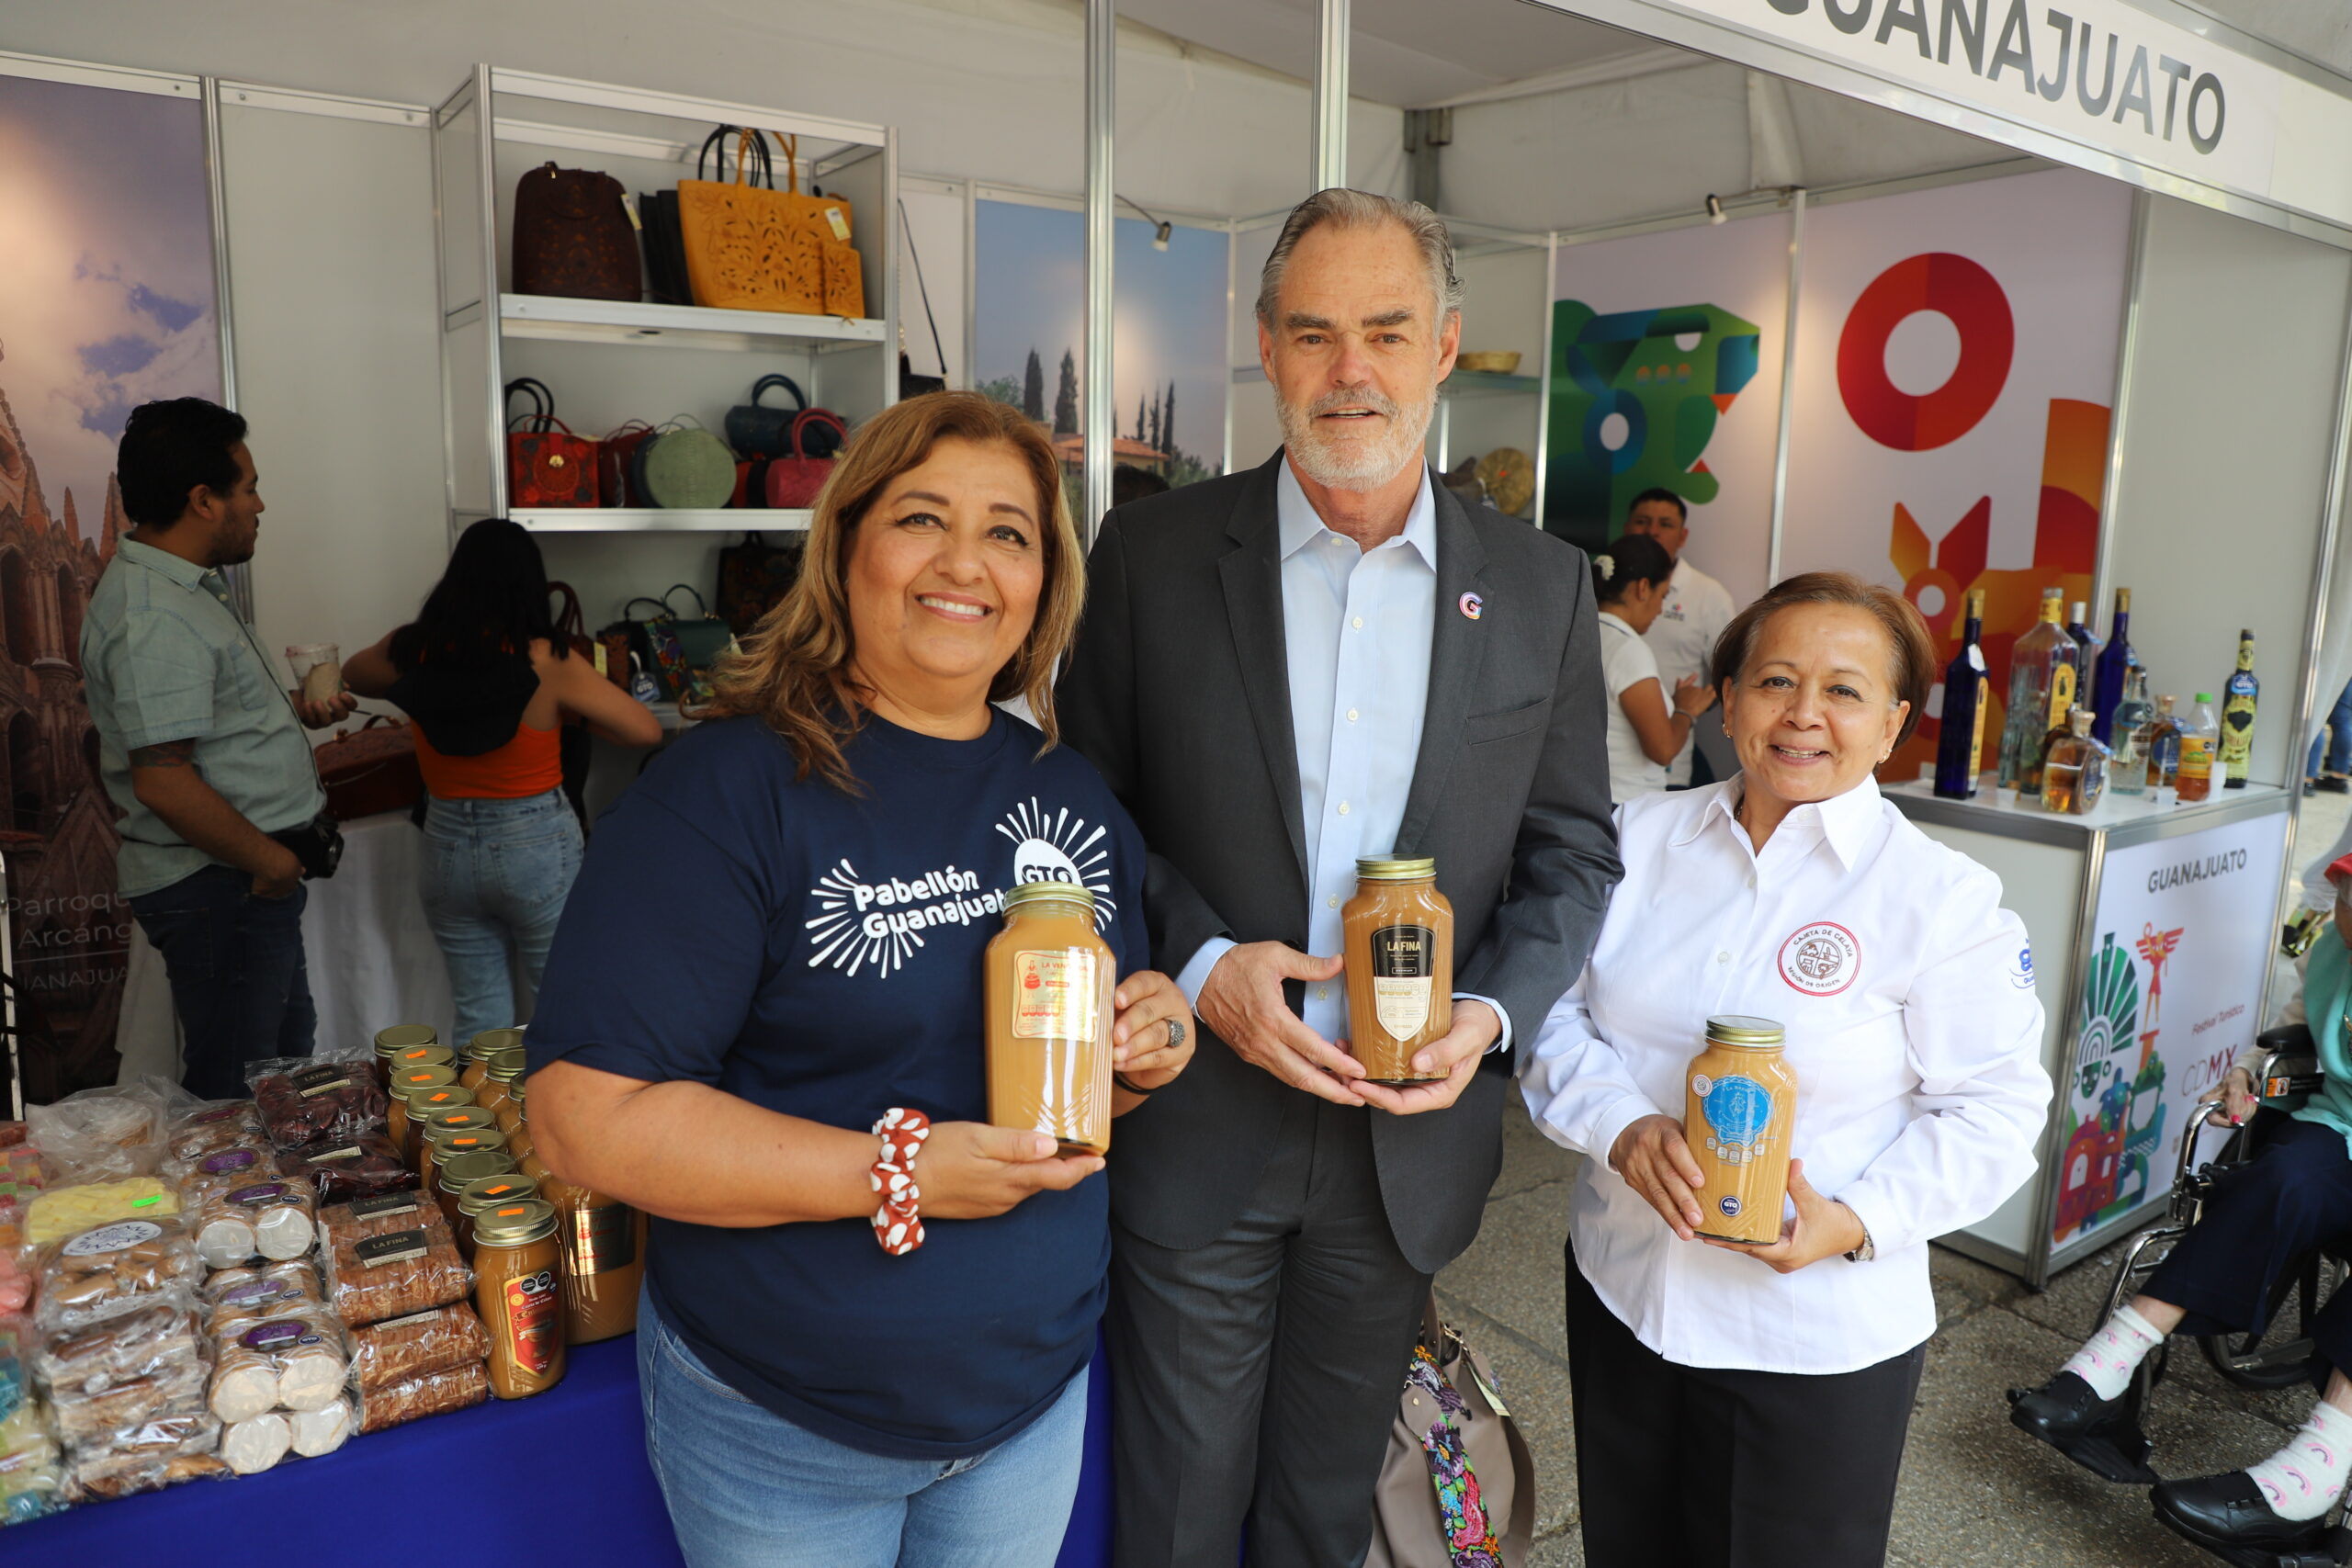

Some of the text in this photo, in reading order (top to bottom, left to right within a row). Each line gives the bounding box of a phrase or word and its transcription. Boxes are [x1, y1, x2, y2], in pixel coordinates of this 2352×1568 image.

[1765, 0, 2225, 155] ANAJUATO
[1022, 864, 1073, 884] GTO
[2147, 848, 2247, 894] GUANAJUATO
[854, 865, 980, 911] Pabellón
[1387, 942, 1421, 952] LA FINA
[1793, 930, 1819, 946] CAJETA
[1834, 933, 1853, 957] CELAYA
[1815, 978, 1840, 988] ORIGEN
[2181, 1043, 2238, 1097] CDMX
[378, 1196, 400, 1205] FINA
[372, 1236, 410, 1250] LA FINA
